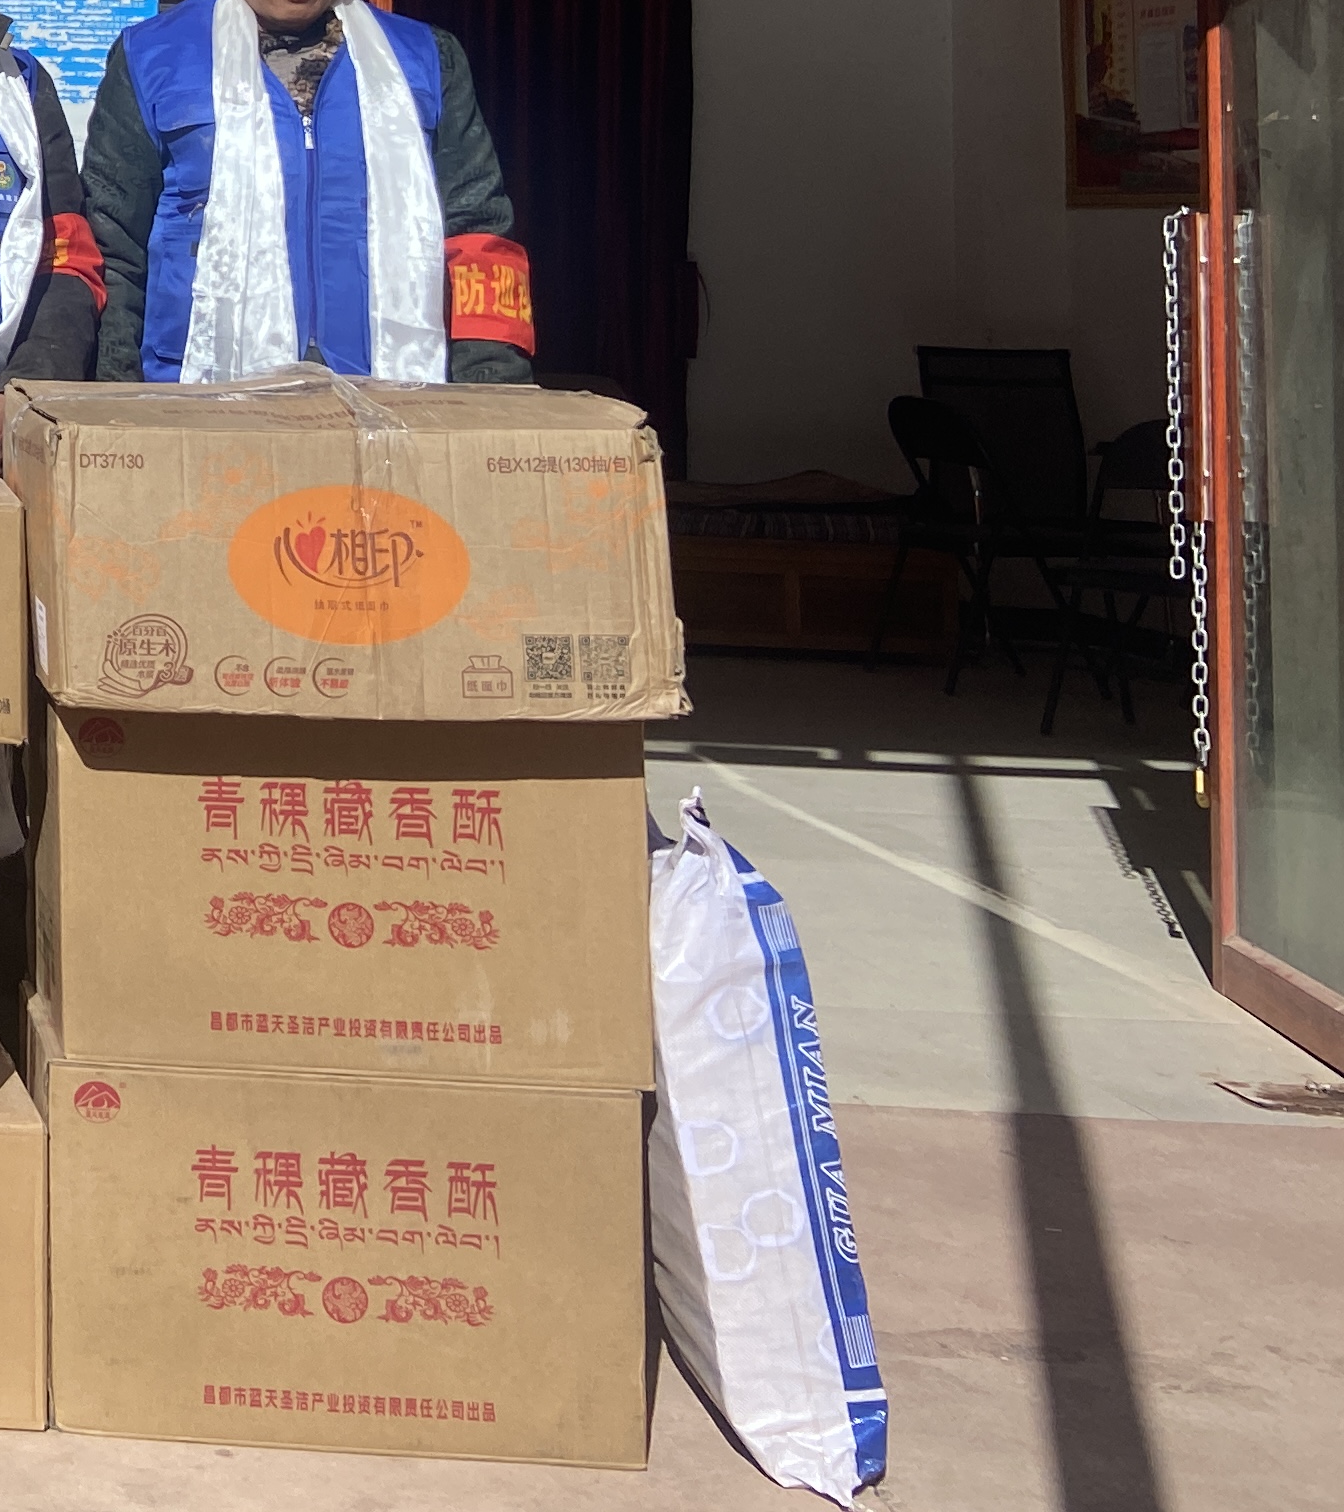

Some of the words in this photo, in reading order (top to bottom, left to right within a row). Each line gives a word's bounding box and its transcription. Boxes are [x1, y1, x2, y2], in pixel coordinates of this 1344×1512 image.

[78, 453, 144, 470] DT37130
[132, 625, 167, 637] 百分百
[118, 638, 178, 657] 原生木
[198, 777, 502, 850] 青稞藏香酥
[211, 1012, 502, 1044] 昌都市蓝天圣洁产业投资有限责任公司出品
[192, 1145, 496, 1224] 青稞藏香酥
[204, 1385, 495, 1421] 昌都市蓝天圣洁产业投资有限责任公司出品
